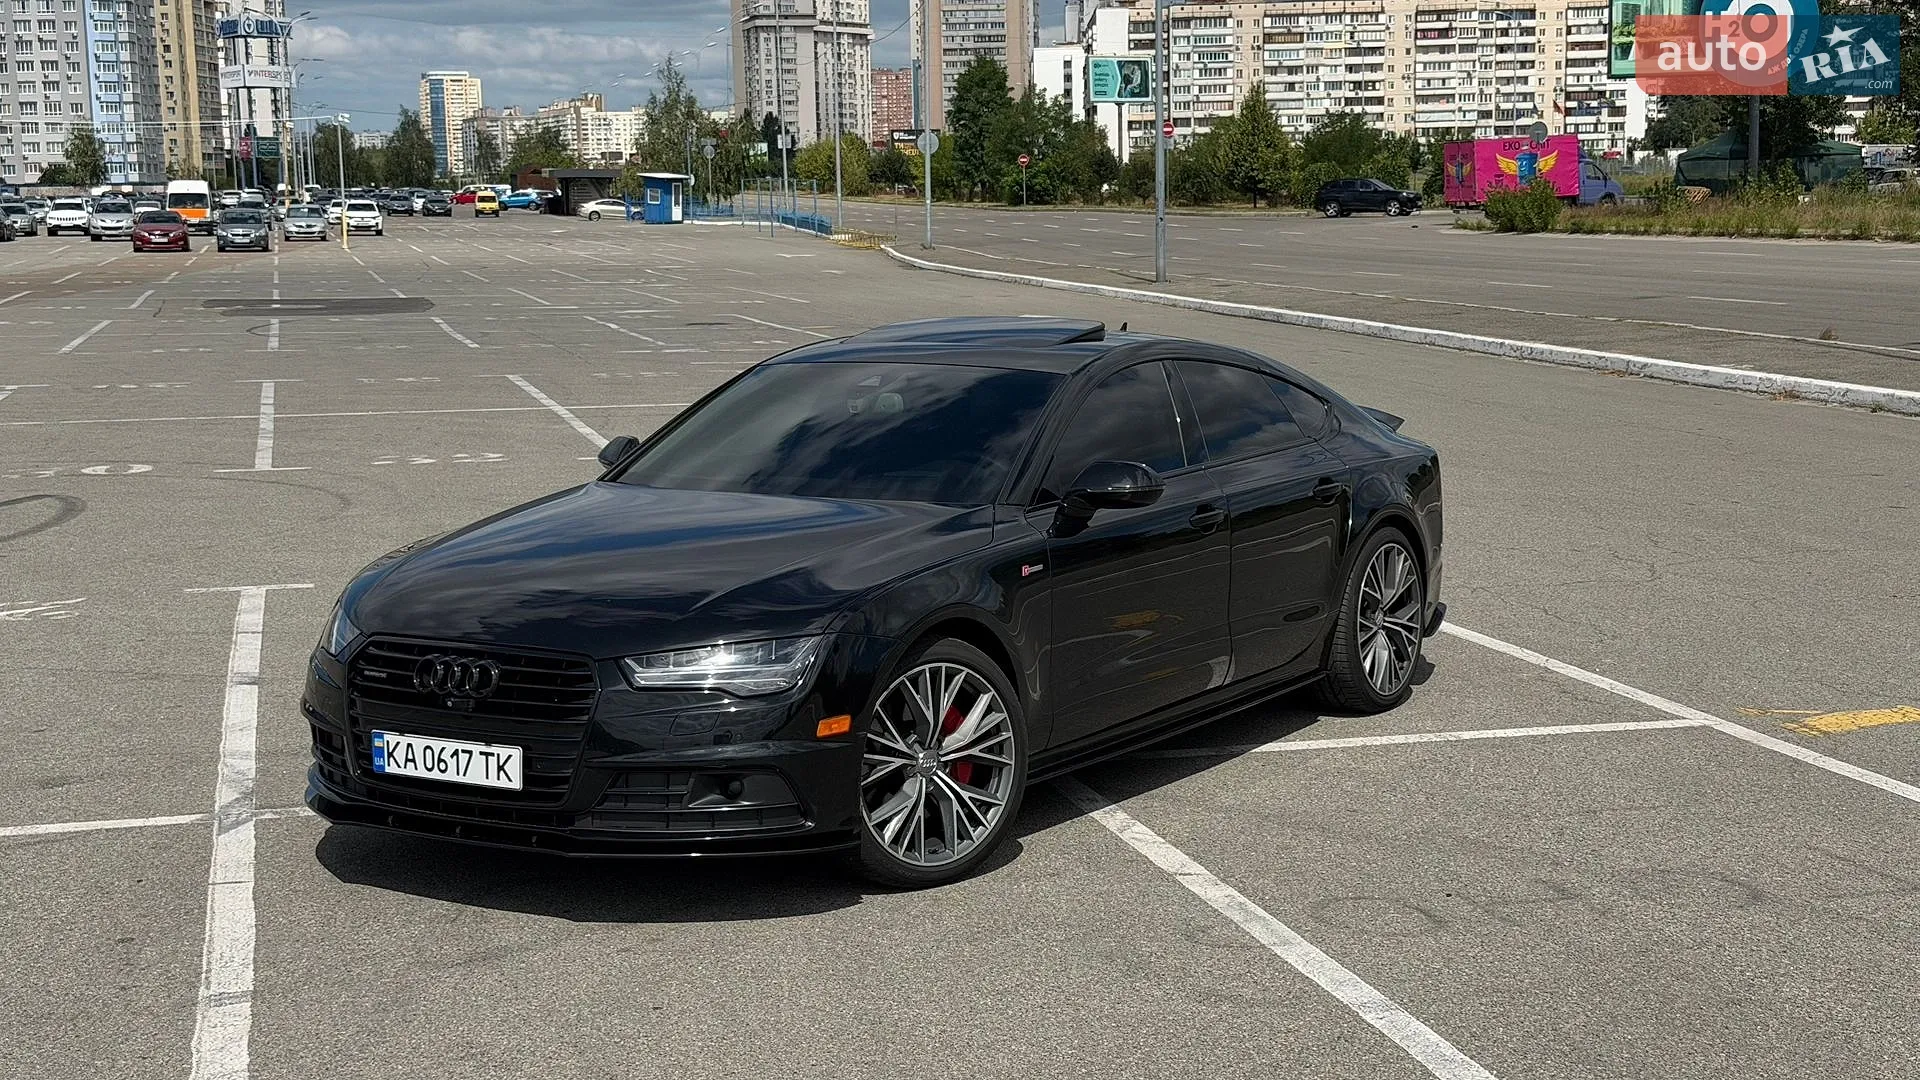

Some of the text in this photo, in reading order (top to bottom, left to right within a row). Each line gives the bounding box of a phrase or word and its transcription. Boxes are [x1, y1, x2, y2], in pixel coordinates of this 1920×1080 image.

[374, 756, 384, 766] UA
[386, 739, 514, 783] KA 0617 TK
